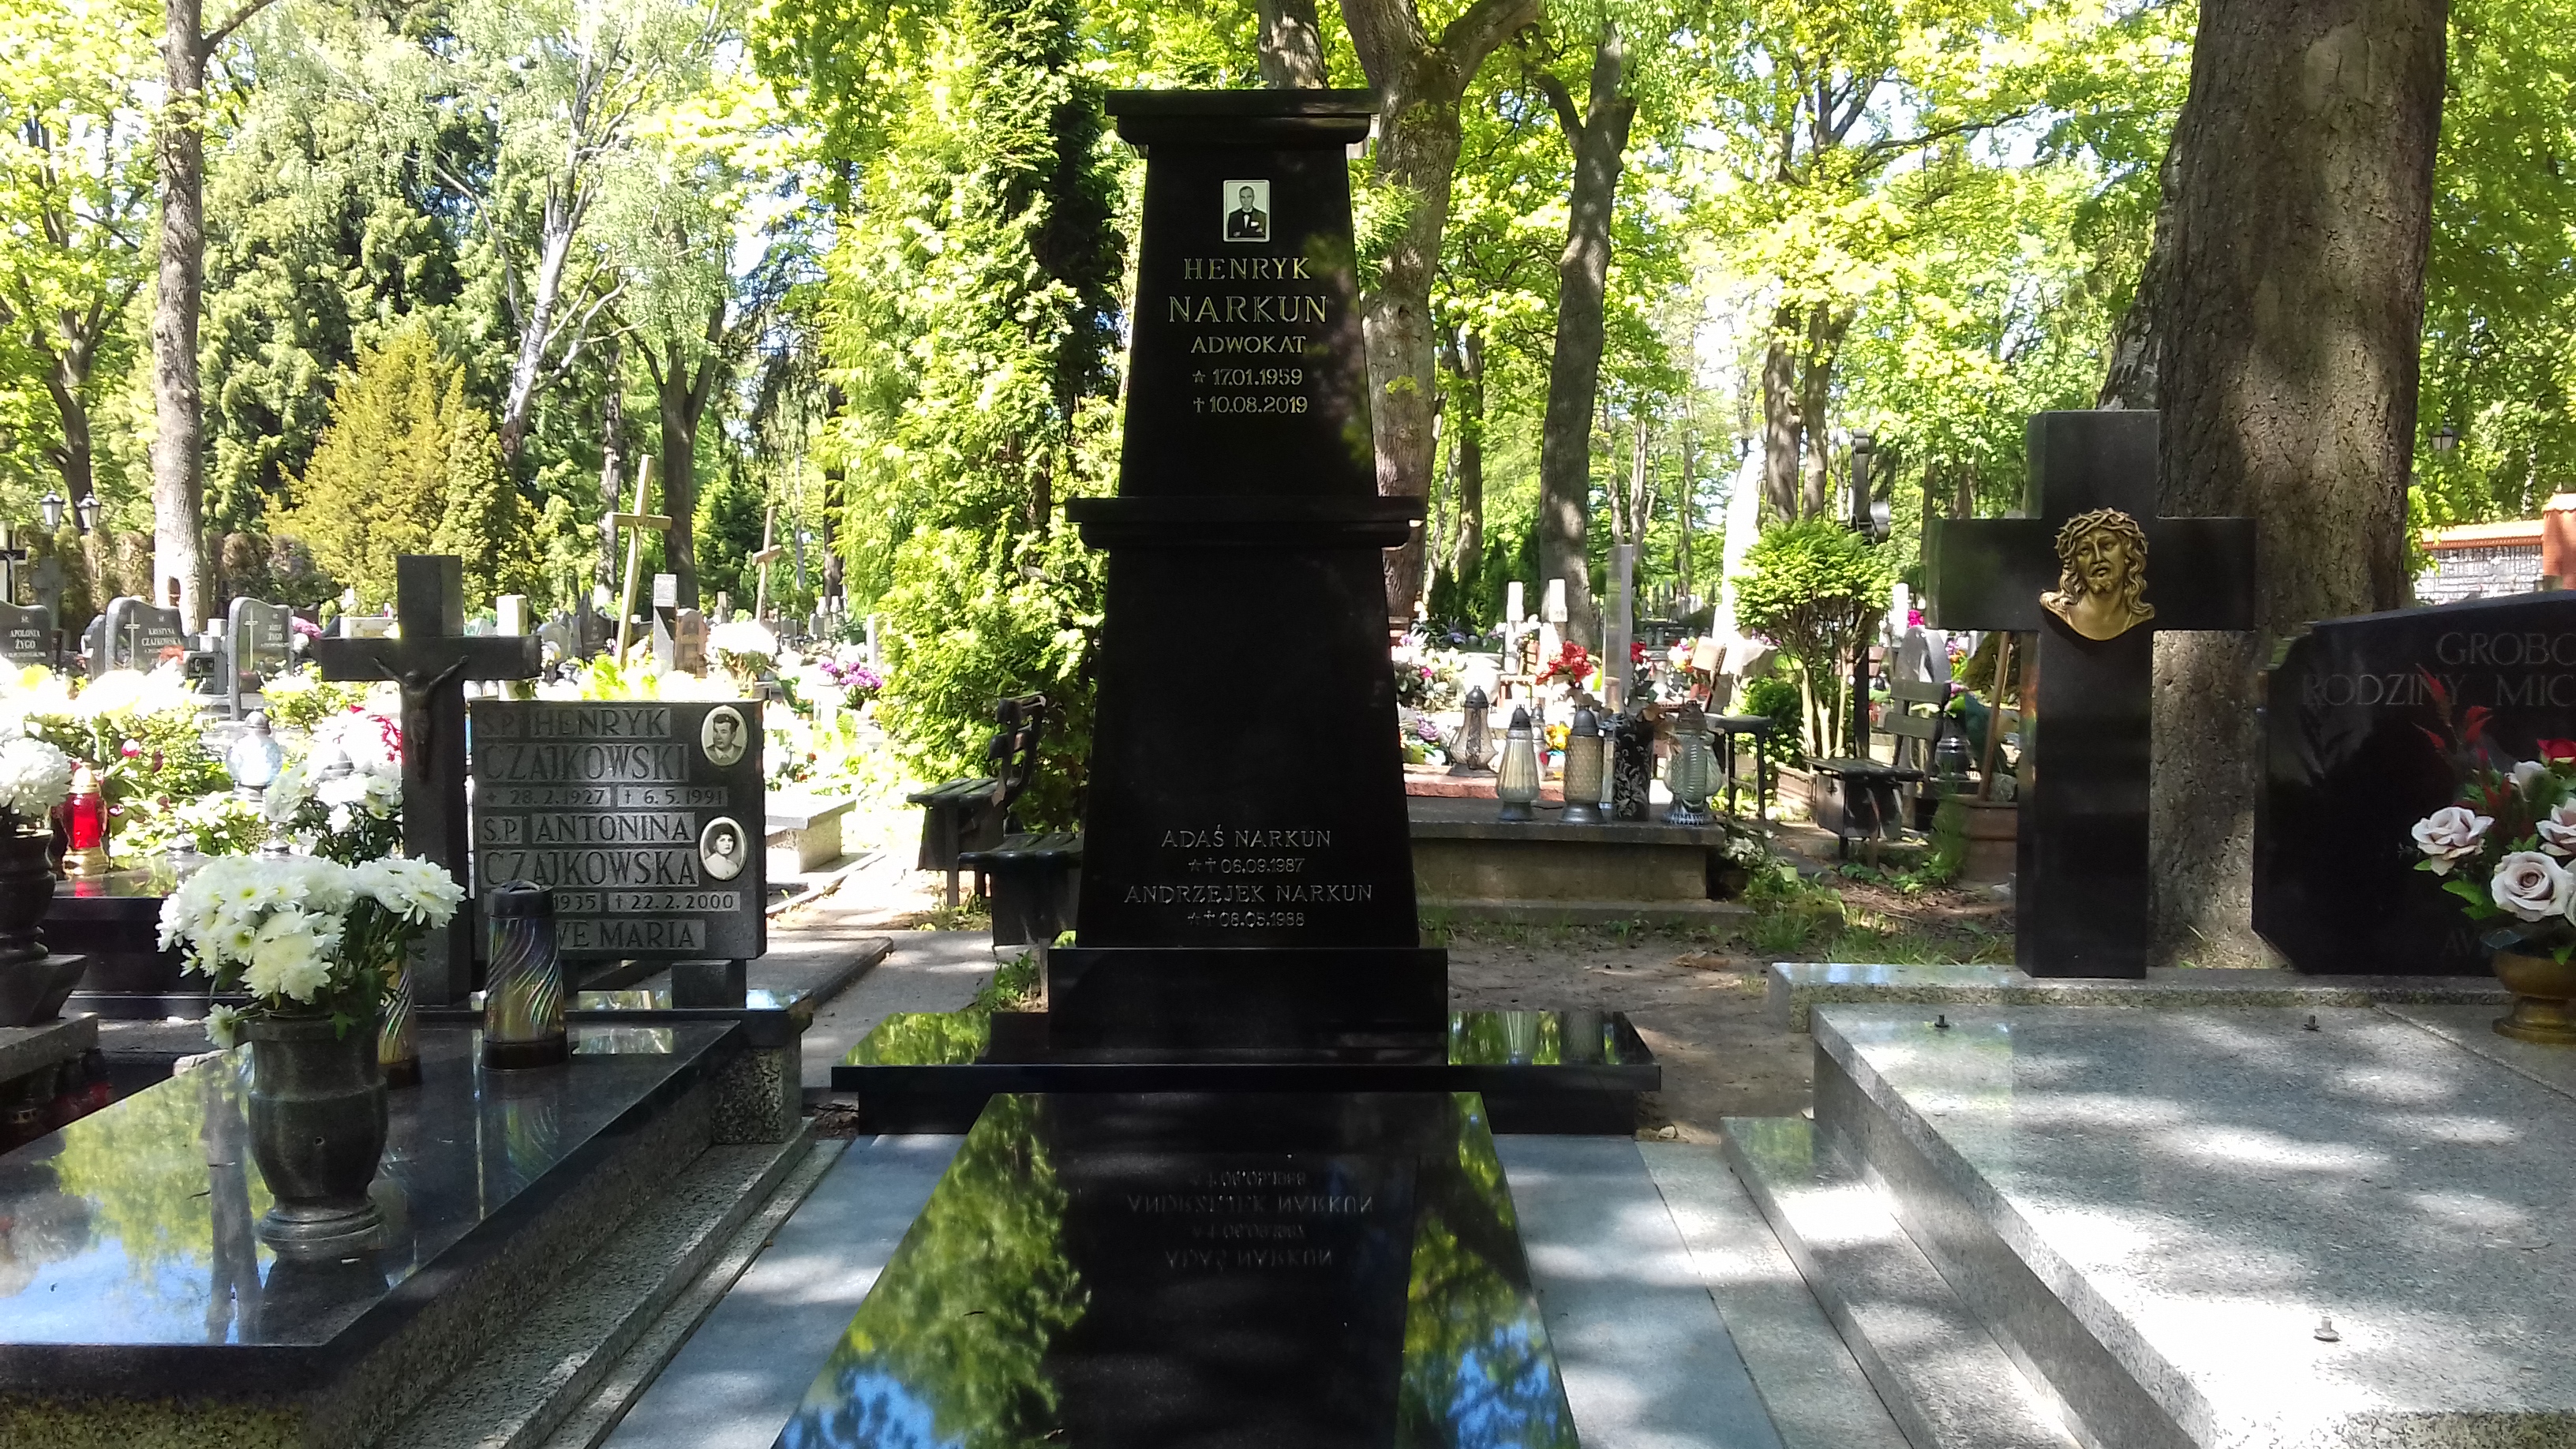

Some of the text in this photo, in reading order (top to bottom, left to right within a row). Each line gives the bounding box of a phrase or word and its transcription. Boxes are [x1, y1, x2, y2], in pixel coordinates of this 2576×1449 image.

[1184, 257, 1311, 280] HENRYK
[1168, 295, 1327, 324] NARKUN
[1190, 335, 1307, 354] ADWOKAT
[1212, 368, 1304, 387] 17.01.1959
[1210, 396, 1309, 414] 10.08.2019
[534, 709, 666, 737] HENRYK
[483, 744, 685, 781] CZAJKOWSKI
[535, 814, 691, 842] ANTONINA
[1161, 824, 1331, 848] ADAŚ NARKUN
[484, 851, 698, 886] CZAJKOWSKA
[1220, 858, 1305, 874] 06.09.1987
[1123, 885, 1372, 904] ANDRZEJEK NARKUN
[1219, 911, 1305, 927] 08.05.1988
[557, 922, 695, 948] VE MARIA
